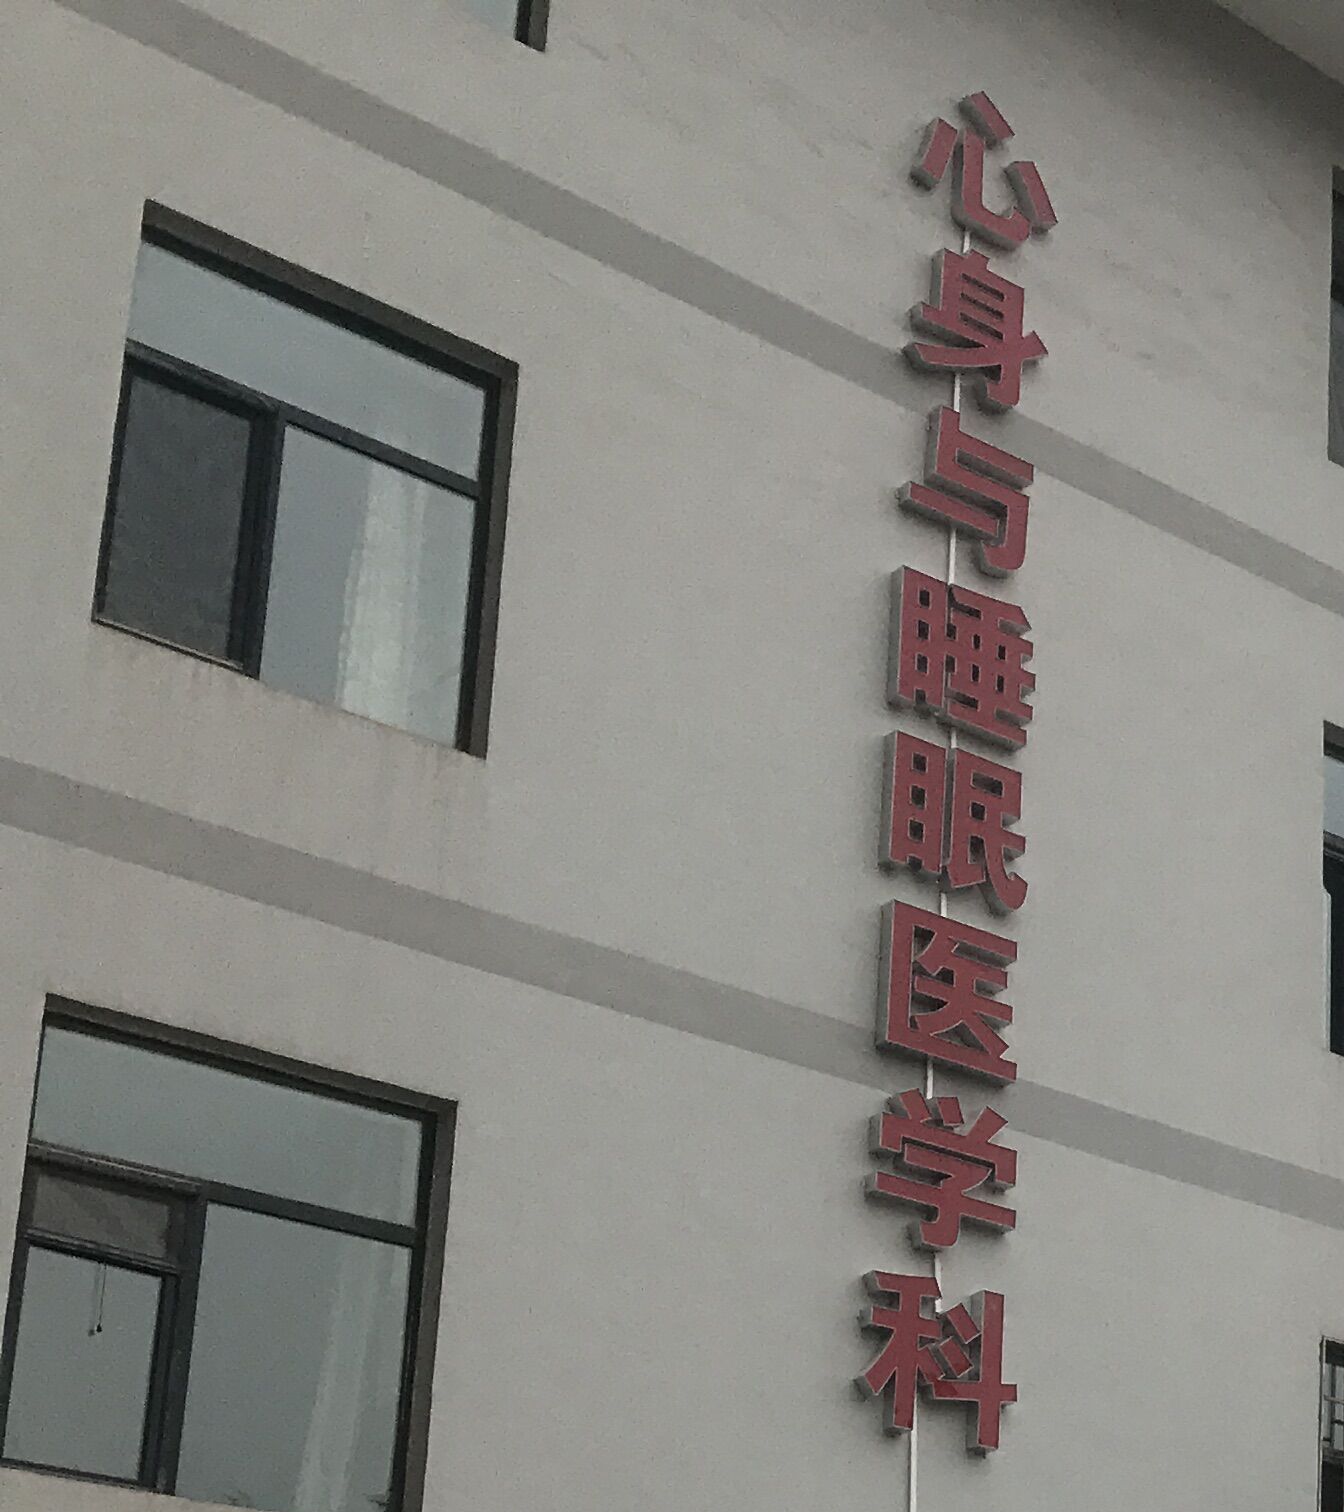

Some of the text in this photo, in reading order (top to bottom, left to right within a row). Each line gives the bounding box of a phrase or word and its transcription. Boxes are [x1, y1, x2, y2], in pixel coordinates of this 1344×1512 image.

[855, 93, 1056, 1450] 心身与睡眠医学科
